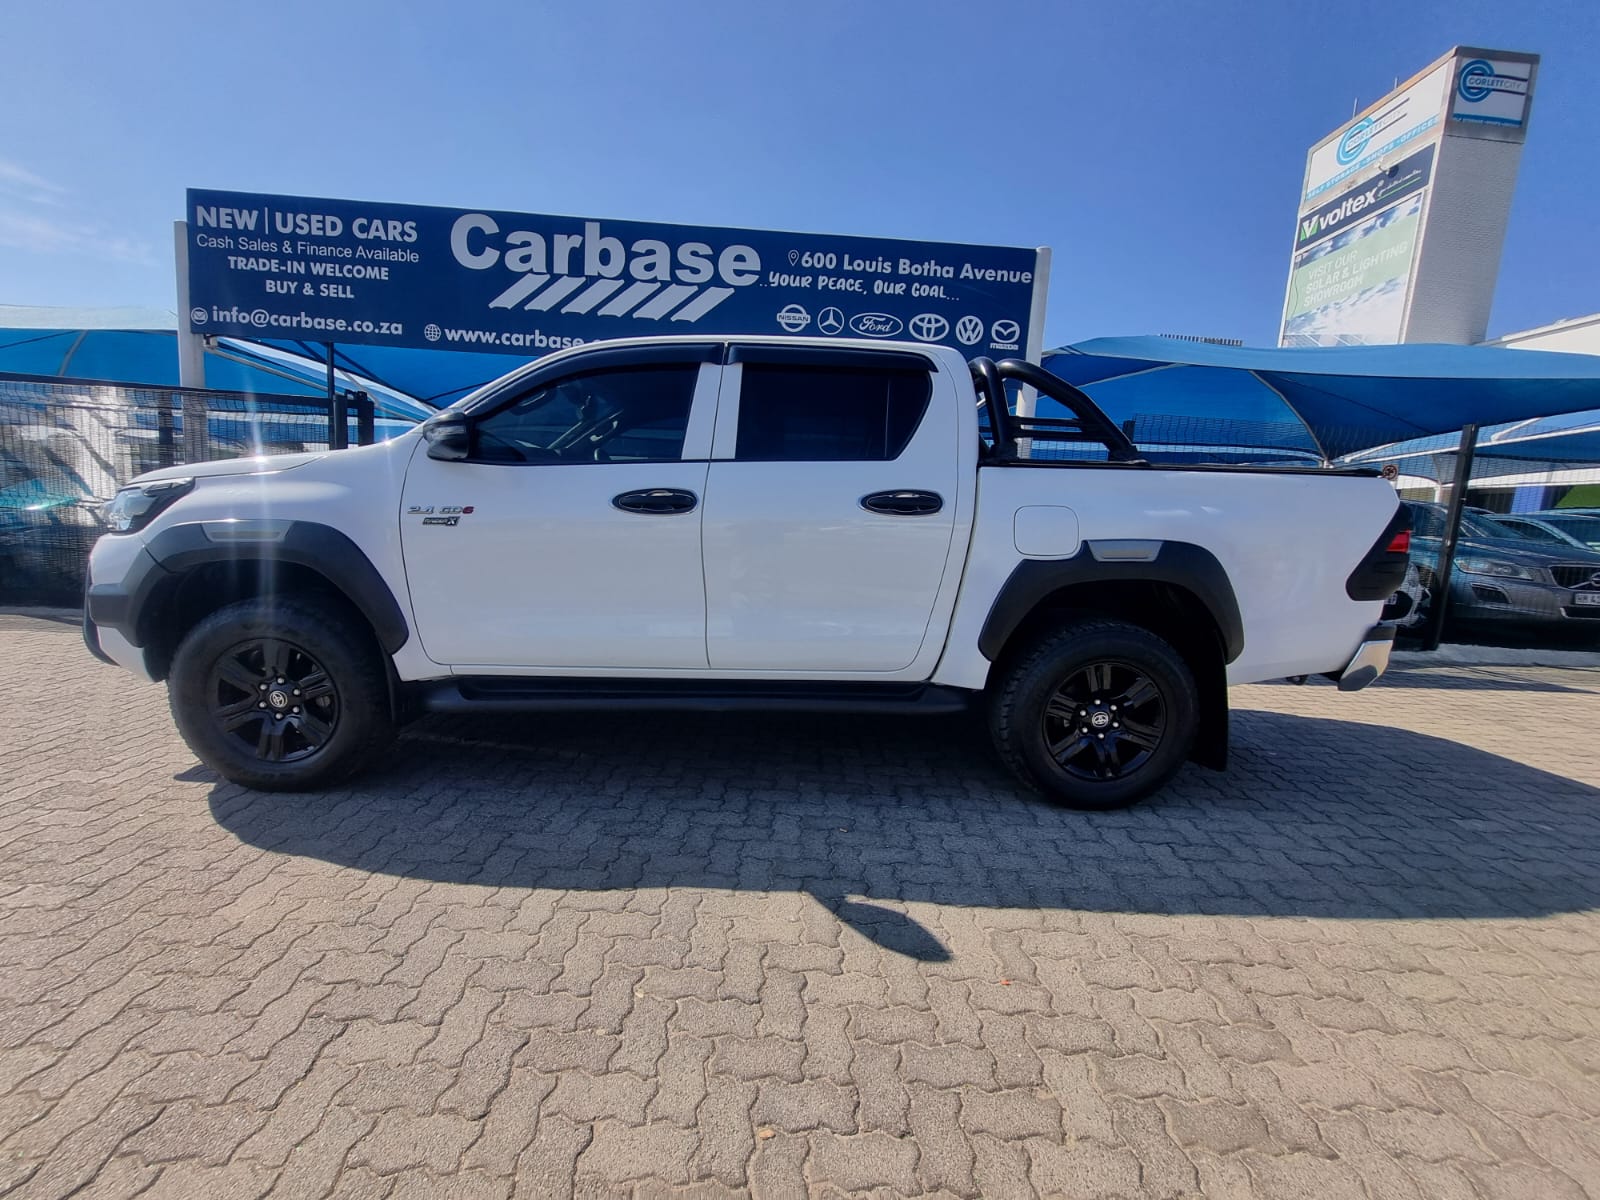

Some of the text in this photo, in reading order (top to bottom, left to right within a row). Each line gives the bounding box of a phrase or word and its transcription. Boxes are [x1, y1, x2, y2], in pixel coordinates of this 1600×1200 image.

[1319, 187, 1379, 230] voltex
[195, 205, 418, 243] NEW USED CARS
[196, 234, 420, 263] Cash Sales & Finance Available
[450, 213, 761, 287] Carbase
[227, 256, 389, 281] TRADE-IN WELCOME
[801, 252, 1033, 284] 600 Louis Botha Avenue
[265, 280, 355, 299] BUY & SELL
[873, 279, 907, 295] OUR
[212, 305, 403, 335] info@carbase.co.za
[778, 314, 894, 332] NISSAN Ford
[444, 328, 600, 349] www.carbase
